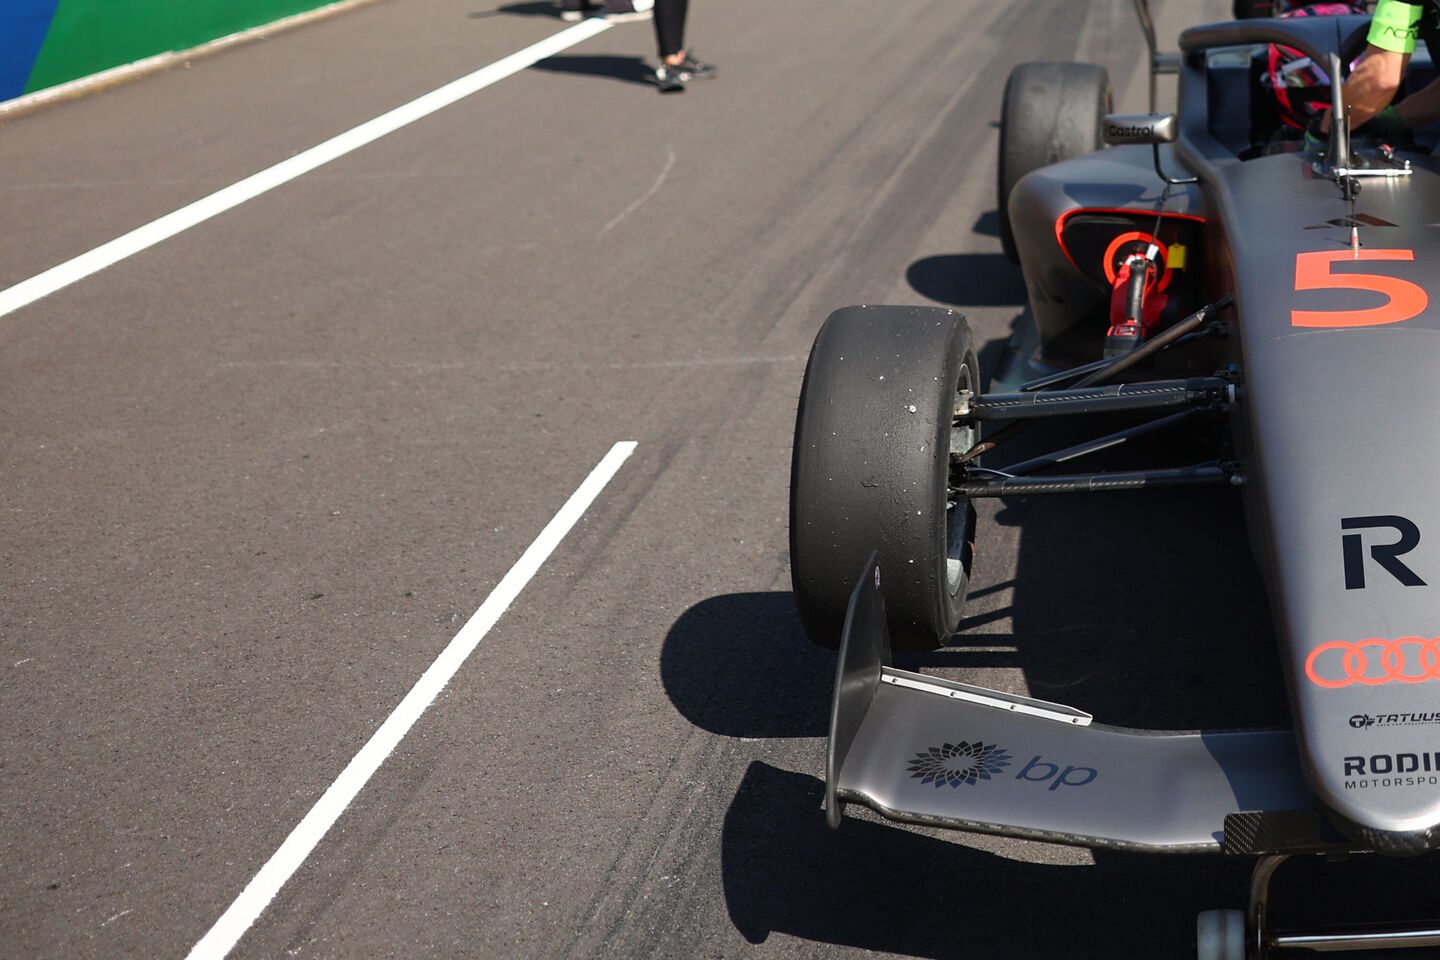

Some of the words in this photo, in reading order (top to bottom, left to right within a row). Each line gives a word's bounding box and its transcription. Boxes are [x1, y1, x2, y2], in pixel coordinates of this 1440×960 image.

[1108, 124, 1155, 137] Castrol
[1290, 248, 1430, 328] 5
[1340, 514, 1428, 590] R
[1014, 755, 1099, 792] bp
